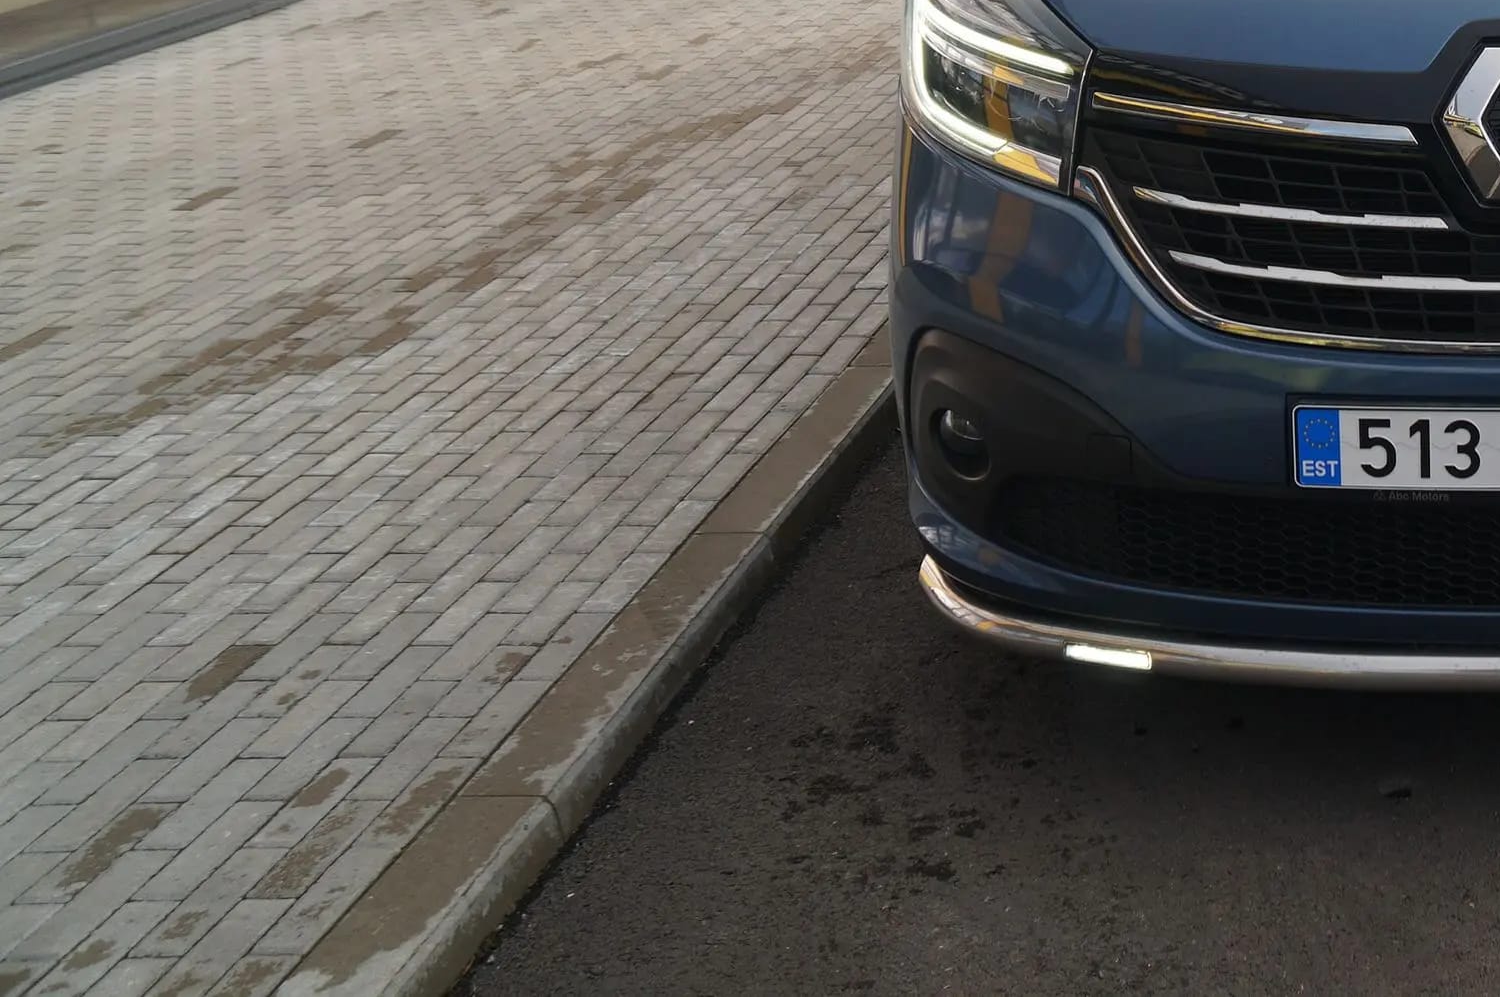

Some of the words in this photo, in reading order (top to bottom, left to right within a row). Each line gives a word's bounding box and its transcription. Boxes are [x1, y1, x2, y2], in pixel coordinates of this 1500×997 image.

[1358, 418, 1481, 479] 513
[1302, 460, 1339, 478] EST
[1412, 490, 1449, 502] Motors
